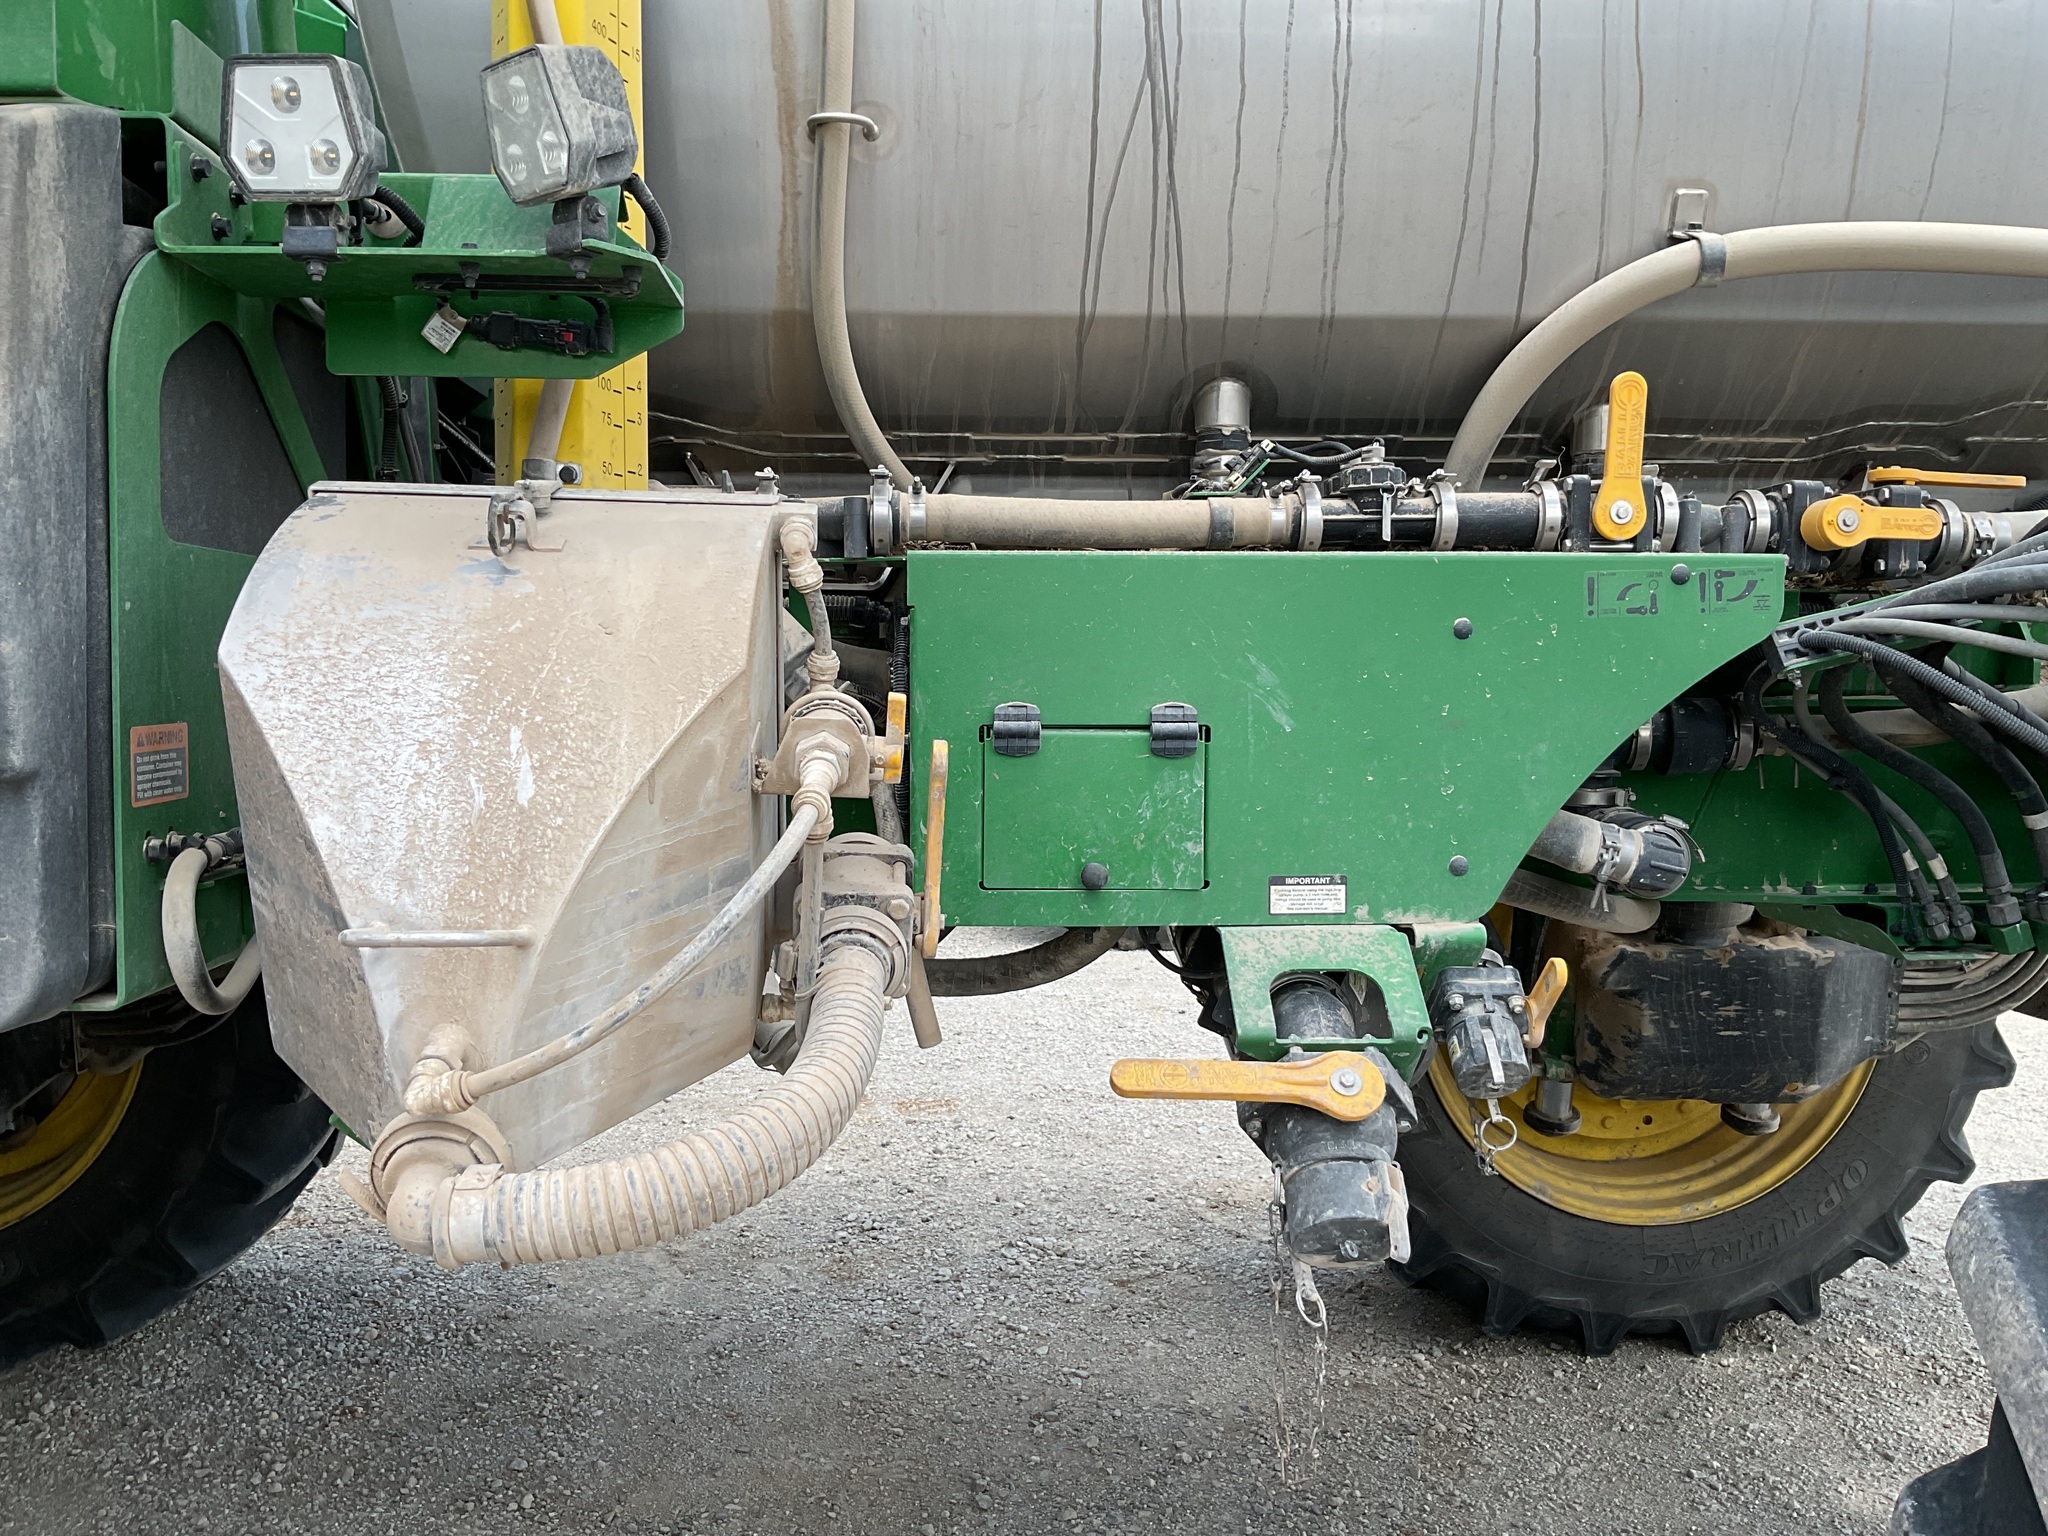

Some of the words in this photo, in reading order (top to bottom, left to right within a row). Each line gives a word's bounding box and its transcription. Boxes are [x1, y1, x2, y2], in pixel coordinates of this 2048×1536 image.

[592, 19, 606, 38] 400
[632, 46, 640, 62] 15
[597, 374, 612, 392] 100
[636, 380, 642, 393] 4
[602, 410, 612, 426] 75
[637, 412, 642, 426] 3
[602, 461, 612, 476] 50
[638, 464, 642, 476] 2
[145, 729, 184, 746] WARNING
[1642, 1157, 1868, 1277] OPTITRAC
